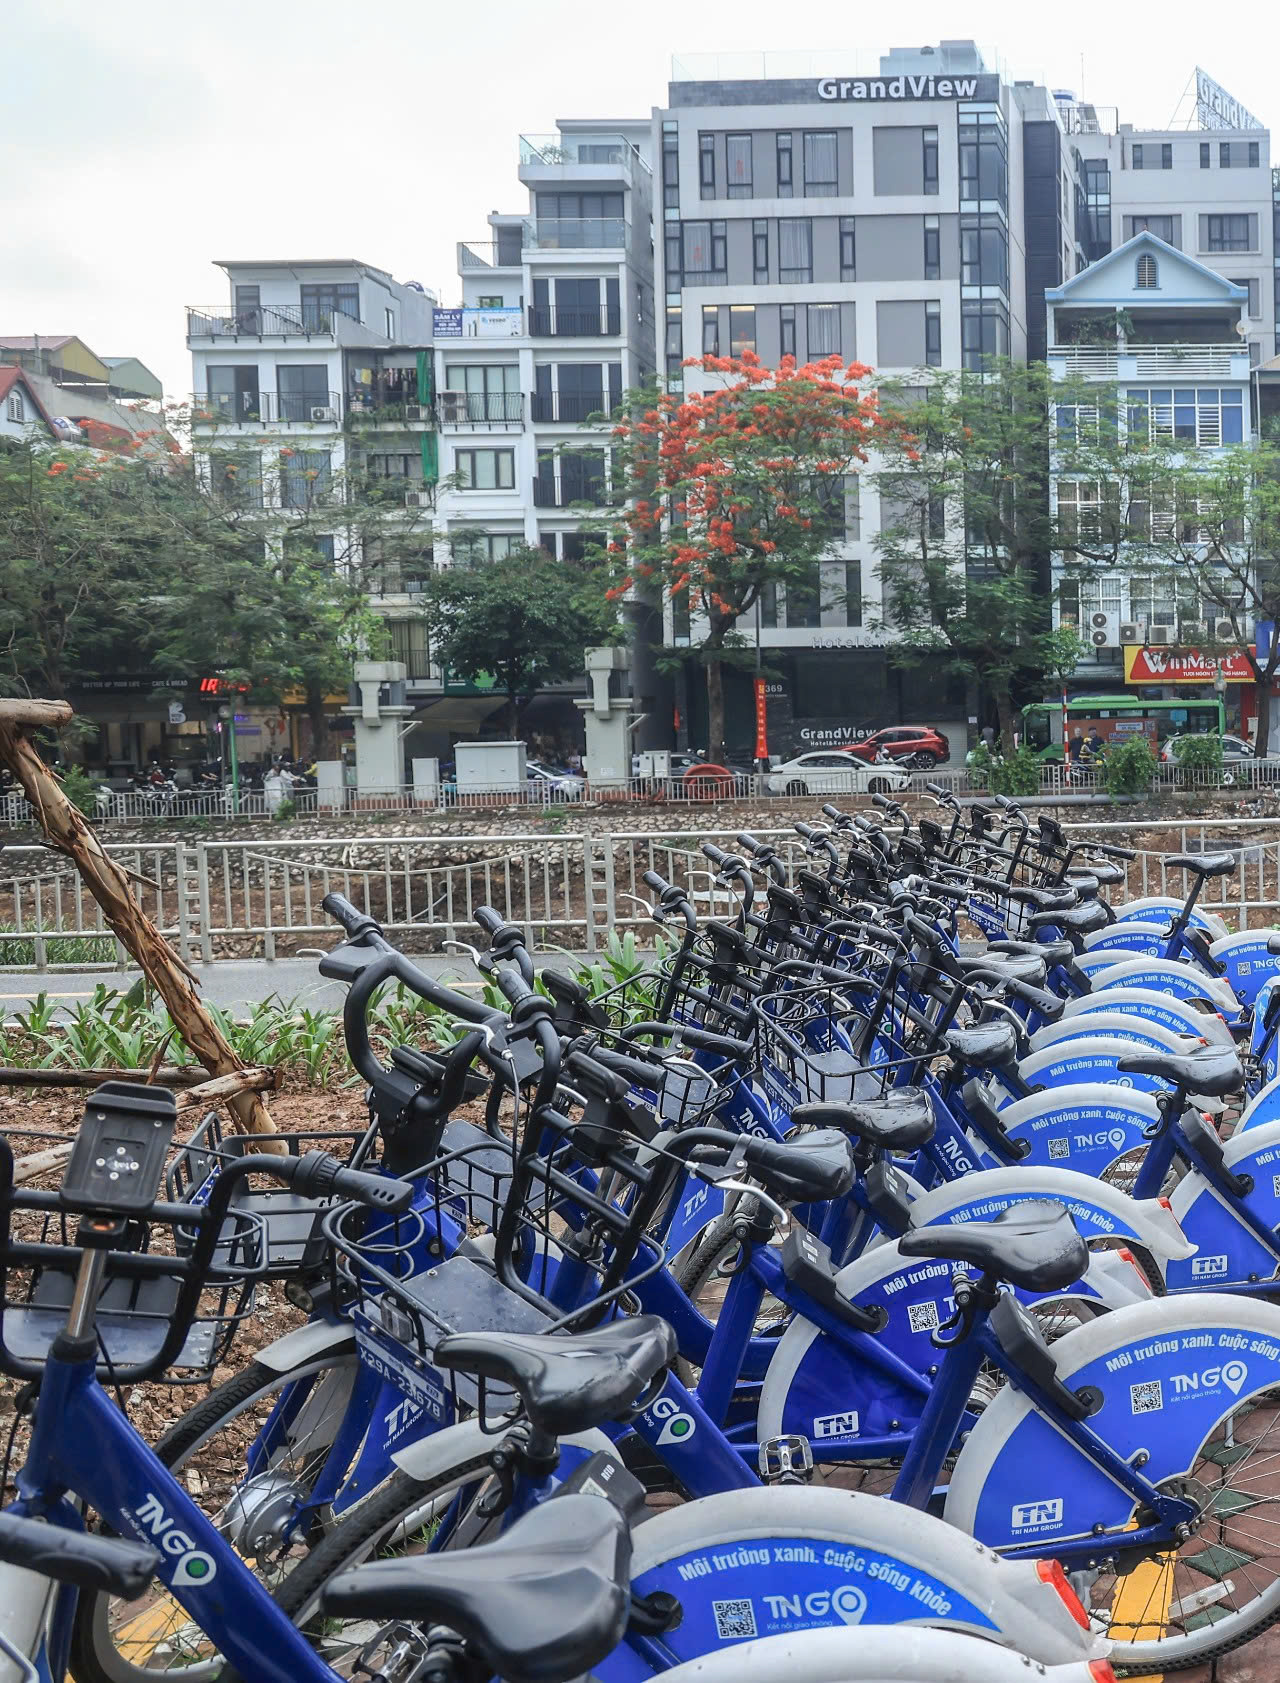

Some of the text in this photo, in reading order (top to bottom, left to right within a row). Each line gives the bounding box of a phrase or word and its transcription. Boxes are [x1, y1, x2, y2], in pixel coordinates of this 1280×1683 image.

[817, 75, 977, 100] GrandView
[800, 727, 877, 739] GrandView
[1156, 1011, 1172, 1023] sống
[1050, 1065, 1066, 1077] Môi
[1066, 1059, 1093, 1072] trường
[1093, 1058, 1114, 1068] xanh.
[1031, 1109, 1149, 1131] Môi trường xanh. Cuộc sống
[1255, 1153, 1275, 1167] Môi
[949, 1200, 1116, 1233] Môi trường sống khỏe
[1195, 1257, 1225, 1272] TN
[1213, 1271, 1228, 1280] GROUP
[882, 1264, 949, 1296] Môi trường
[1104, 1355, 1132, 1373] Môi
[1133, 1340, 1180, 1360] trường
[1180, 1335, 1216, 1349] xanh.
[1217, 1333, 1248, 1351] Cuộc
[1248, 1337, 1280, 1360] sống
[1169, 1360, 1248, 1395] TNGO
[1192, 1391, 1204, 1401] giao
[1203, 1388, 1221, 1399] thông
[818, 1414, 853, 1434] TN
[382, 1439, 392, 1450] TRI
[392, 1427, 405, 1442] NAM
[600, 1464, 615, 1481] RFID
[1016, 1501, 1059, 1523] TN
[1024, 1526, 1039, 1534] NAM
[1040, 1522, 1064, 1533] GROUP
[135, 1493, 217, 1586] TNGO
[677, 1546, 953, 1616] Môi trường xanh. Cuộc sống khỏe
[762, 1585, 868, 1626] TNGO
